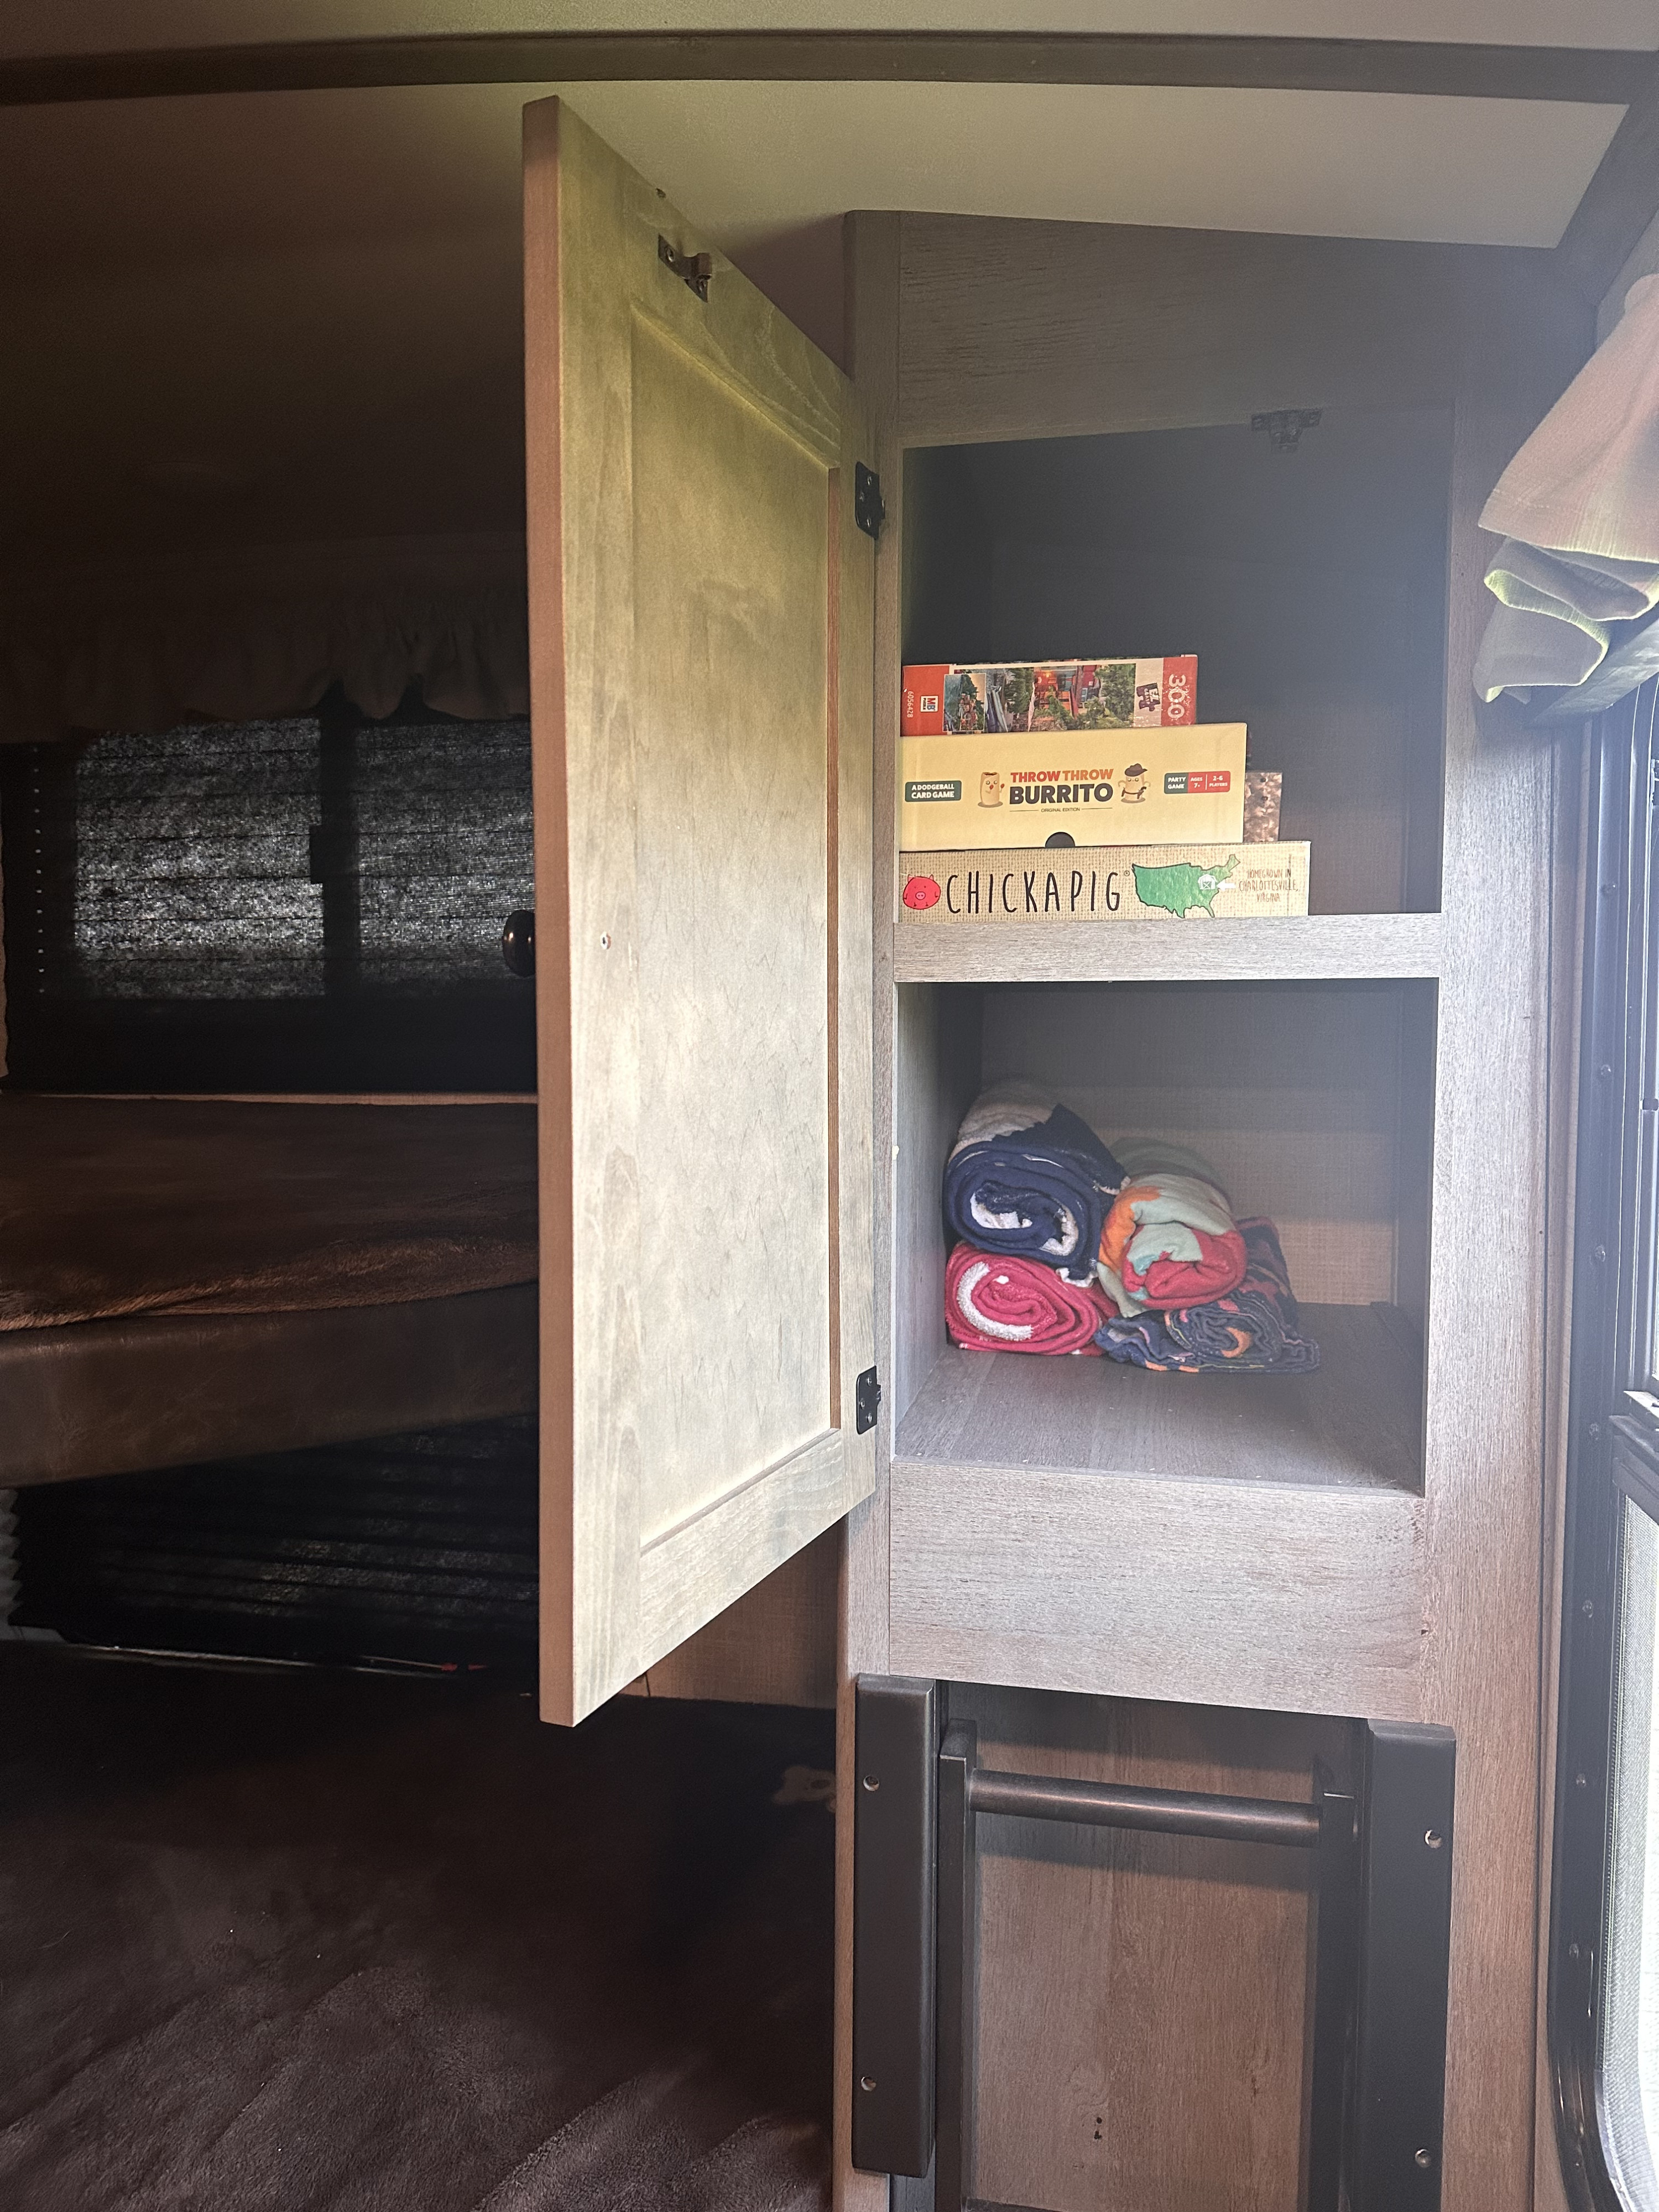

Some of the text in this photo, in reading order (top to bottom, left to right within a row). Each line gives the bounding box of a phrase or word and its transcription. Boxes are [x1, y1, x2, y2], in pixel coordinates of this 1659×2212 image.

[1167, 674, 1186, 719] 300
[1010, 768, 1114, 783] THROW THROW
[1009, 782, 1113, 805] BURRITO
[1247, 868, 1291, 879] HOMEGROWN IN
[946, 870, 1120, 914] CHICKAPIG
